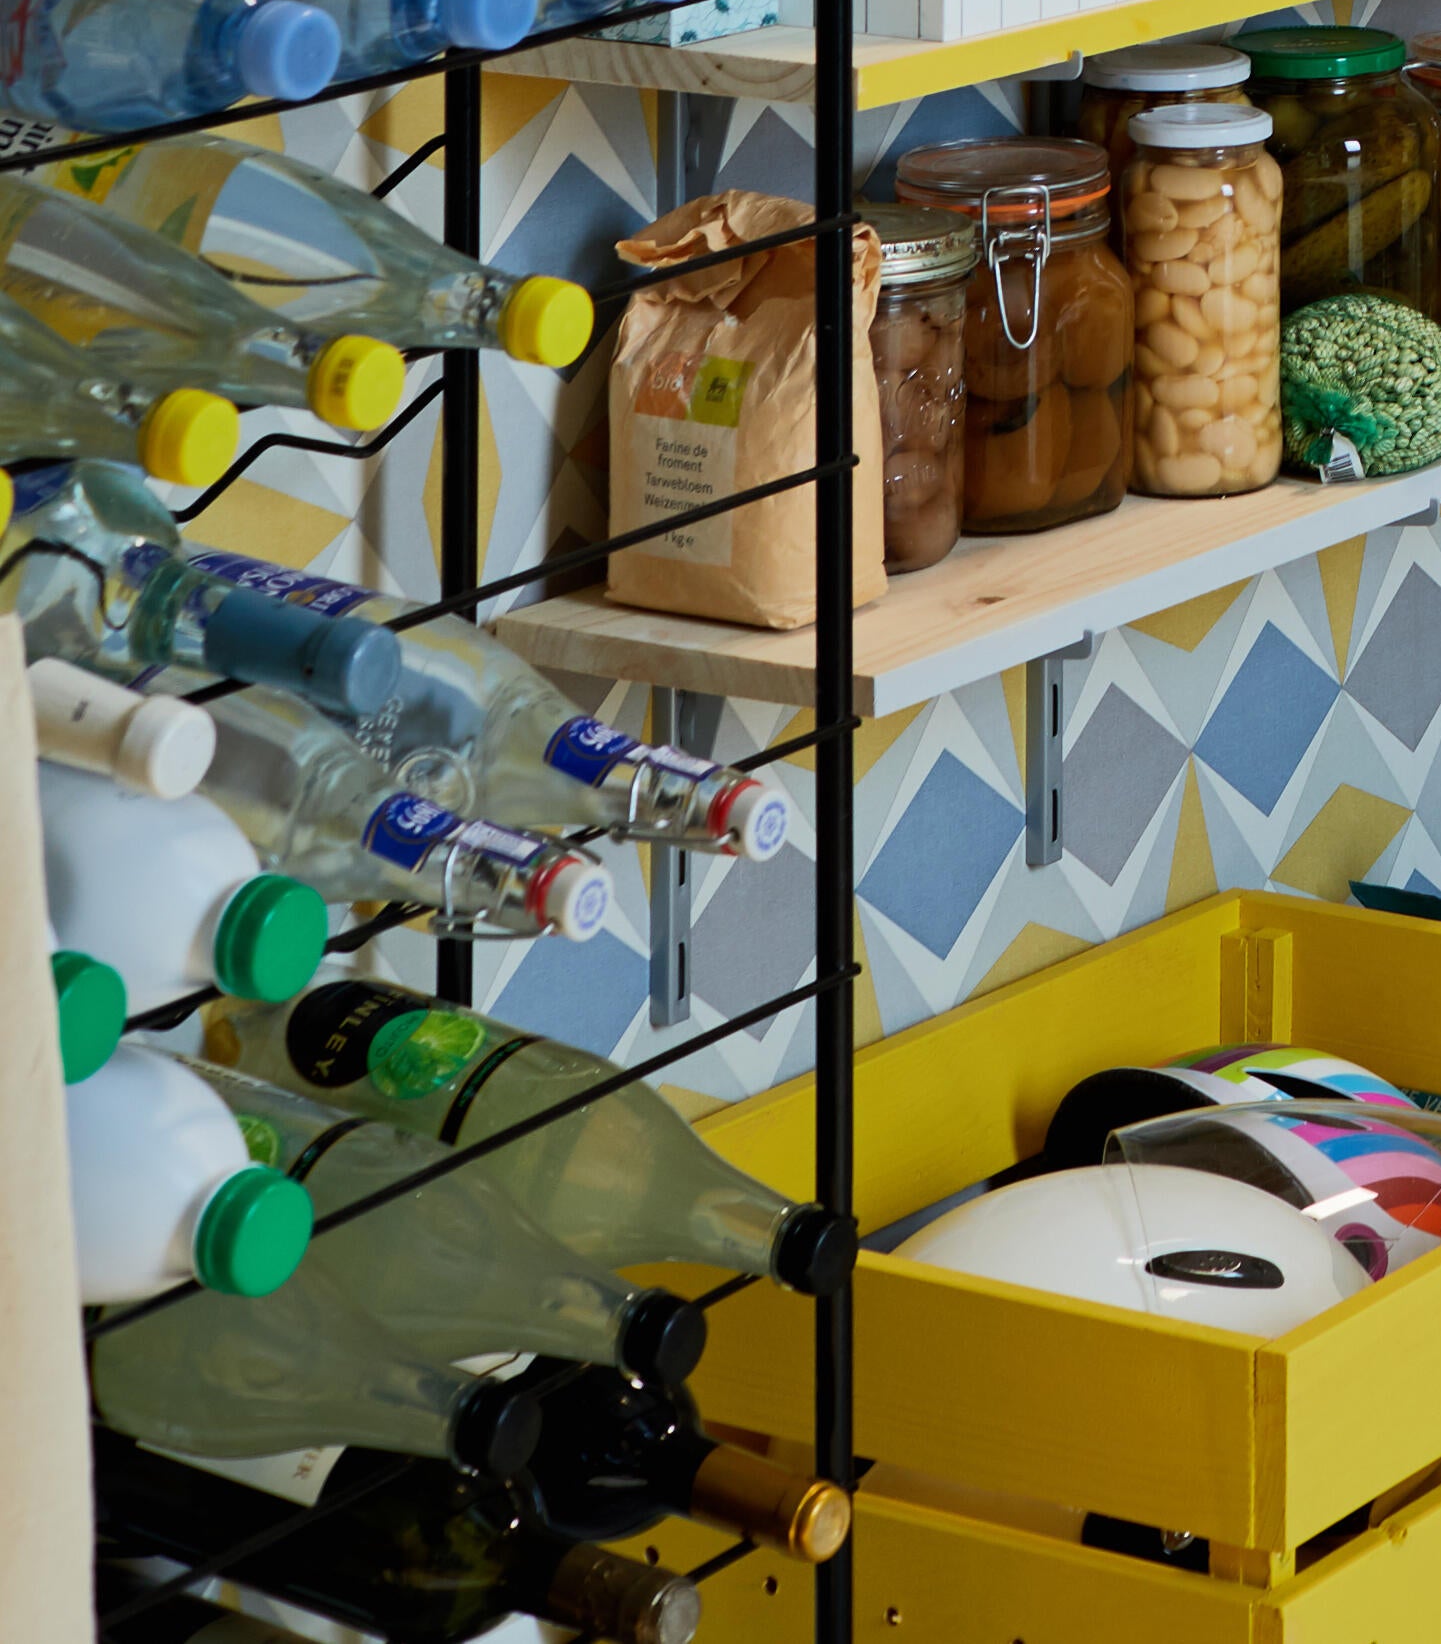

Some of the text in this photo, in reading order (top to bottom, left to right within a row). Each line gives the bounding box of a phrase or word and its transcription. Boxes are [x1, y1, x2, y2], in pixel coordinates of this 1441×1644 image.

[655, 436, 709, 459] Farine de
[657, 453, 704, 474] froment
[644, 471, 714, 496] Tarwebloem
